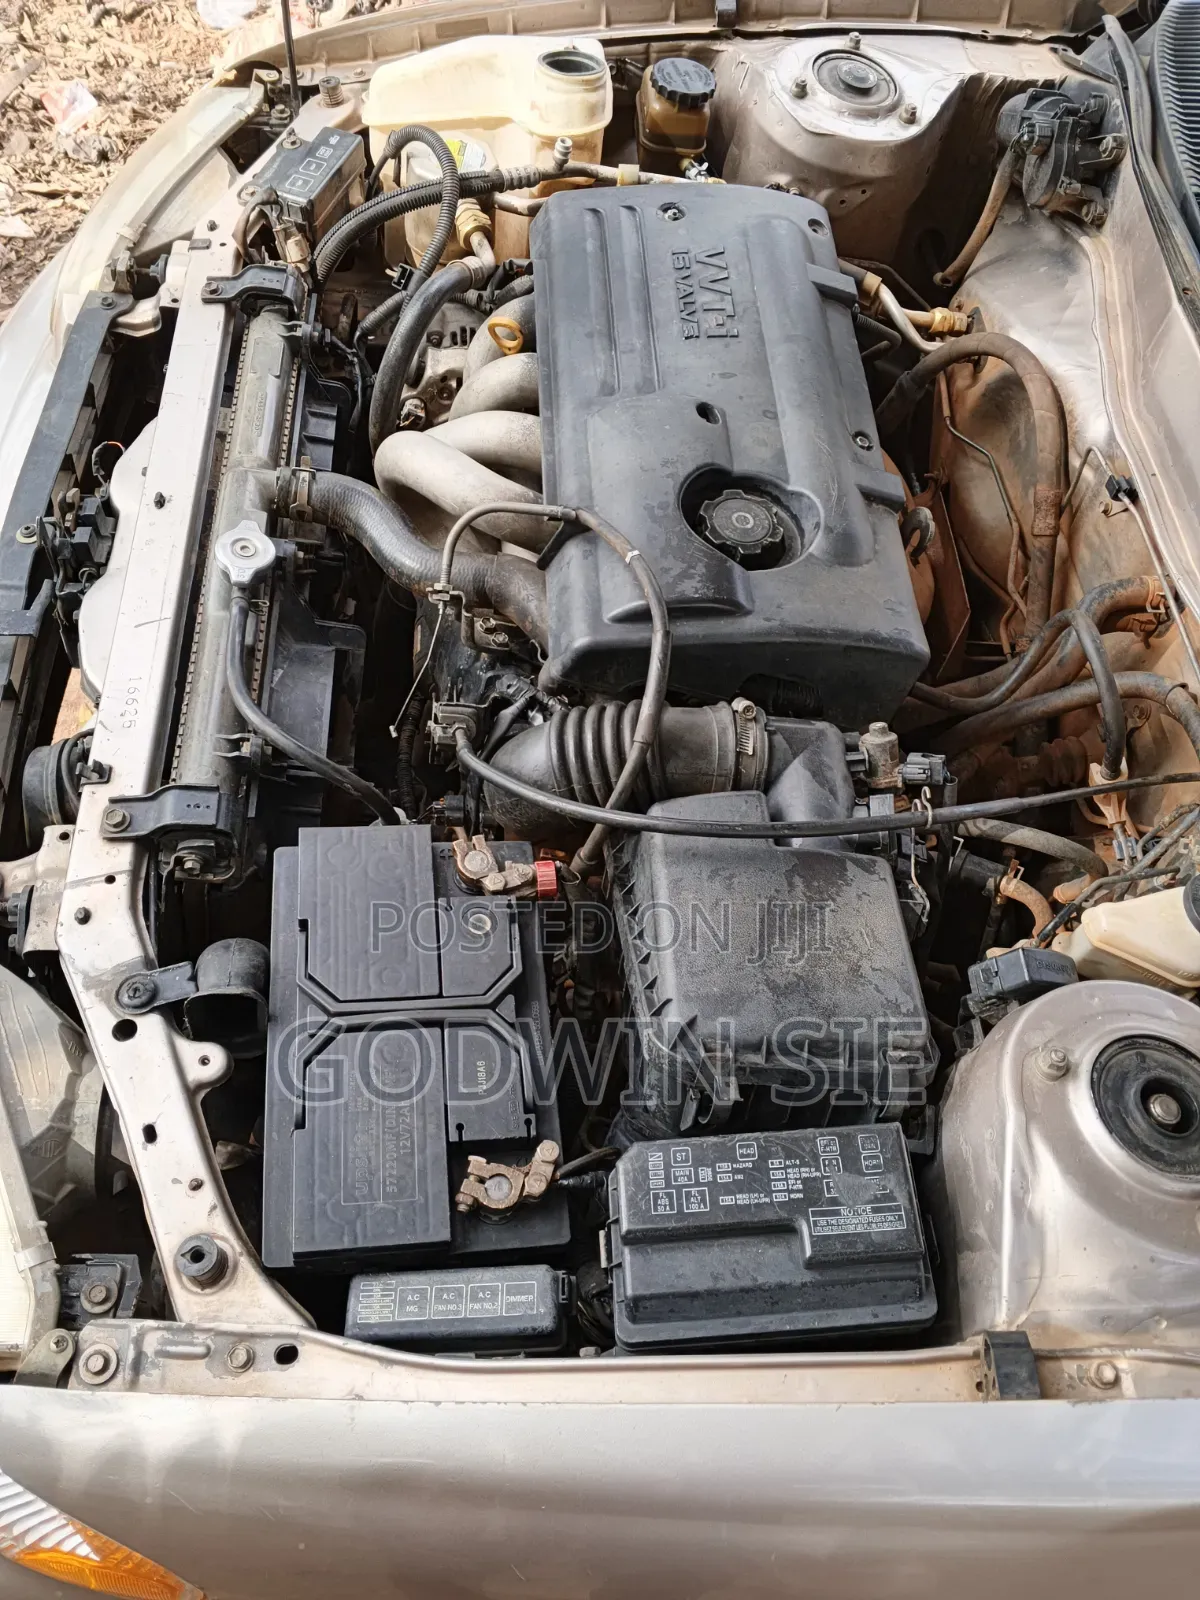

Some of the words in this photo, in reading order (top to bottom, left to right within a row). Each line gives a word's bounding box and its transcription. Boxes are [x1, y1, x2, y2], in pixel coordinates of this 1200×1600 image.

[676, 271, 700, 340] VALVE
[739, 1147, 755, 1155] HEAD
[676, 1152, 686, 1161] ST
[657, 1197, 669, 1205] ABS
[841, 1206, 872, 1217] NOTICE
[817, 1218, 828, 1226] USE
[828, 1217, 838, 1226] THE
[838, 1216, 868, 1225] DESIGNATED
[868, 1215, 886, 1223] FUSES
[505, 1295, 534, 1303] DIMMER
[447, 1303, 463, 1311] NO.3
